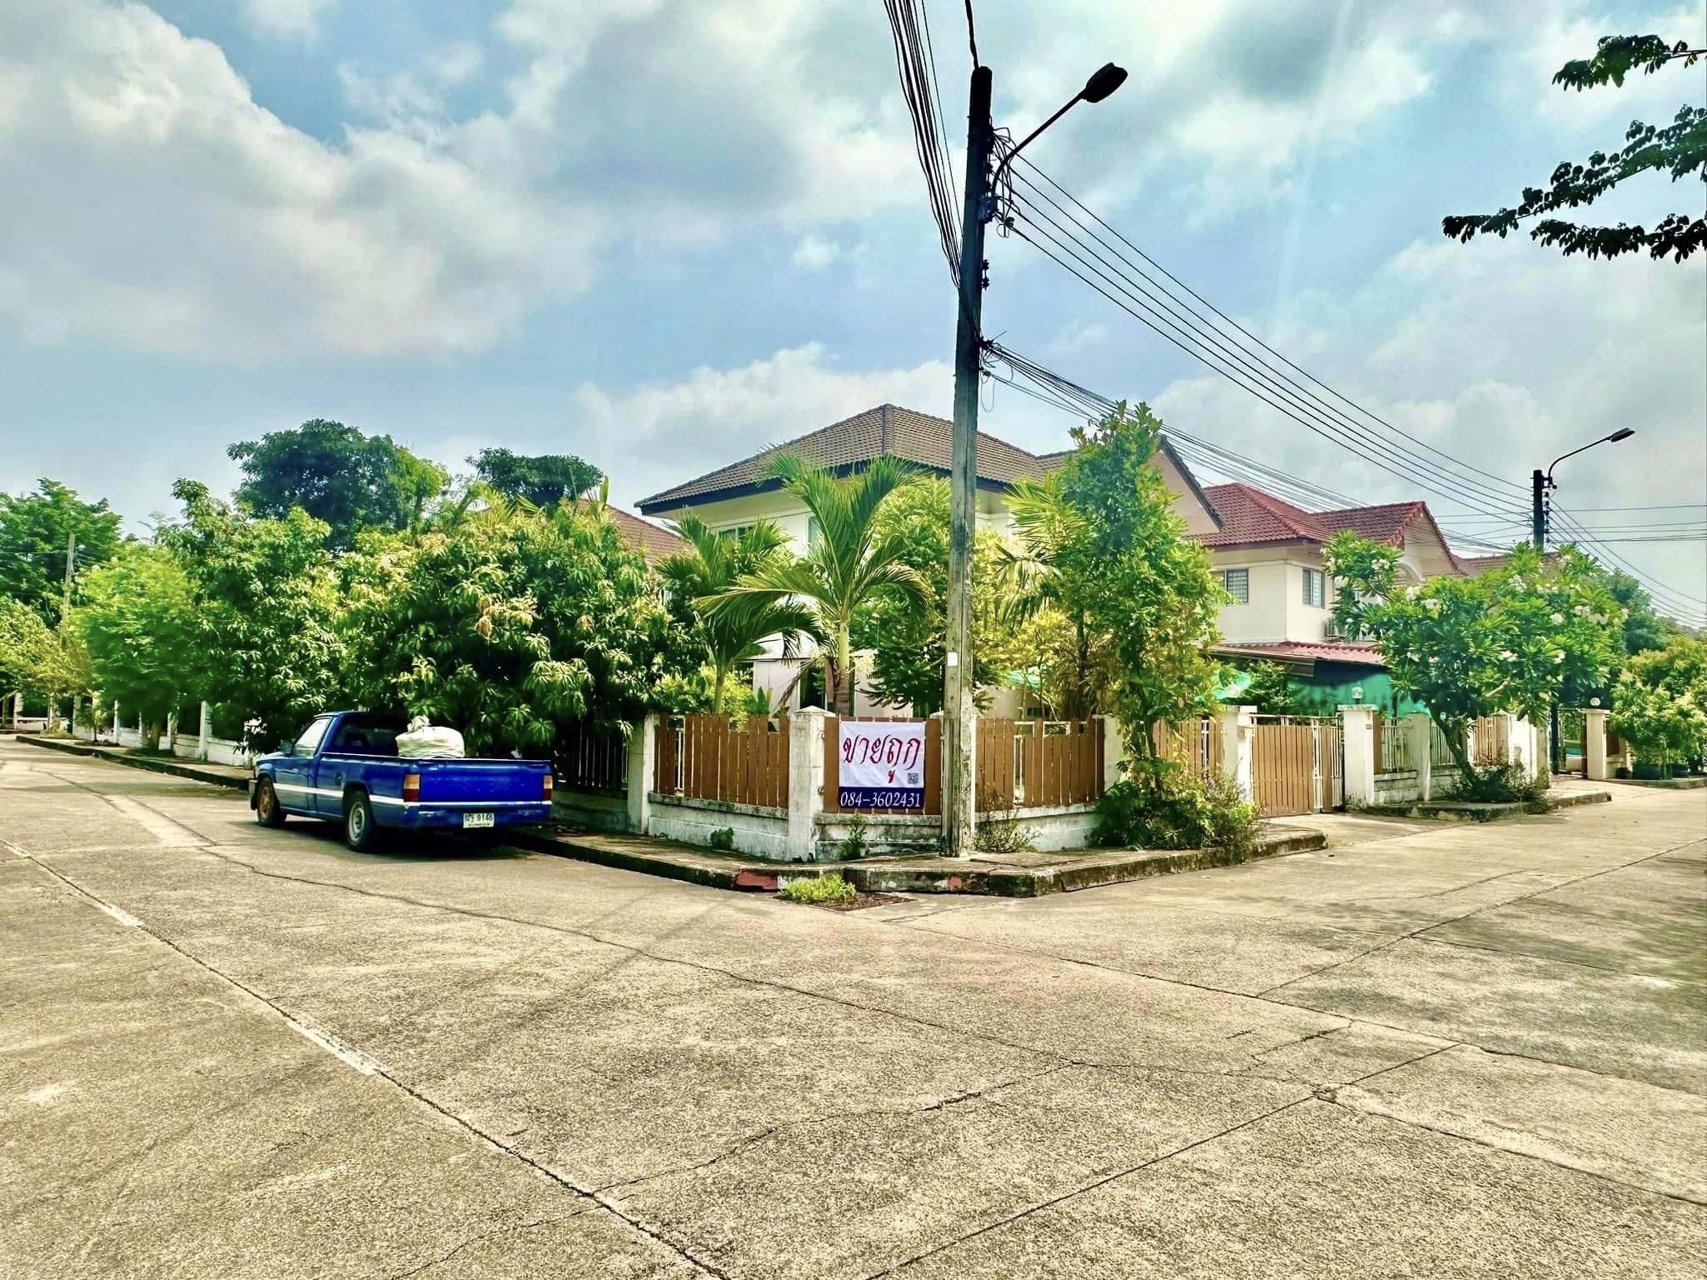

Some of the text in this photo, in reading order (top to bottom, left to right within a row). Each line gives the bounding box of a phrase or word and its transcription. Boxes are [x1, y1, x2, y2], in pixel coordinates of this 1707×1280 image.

[843, 734, 921, 783] ขายถูก
[840, 791, 921, 807] 084-3602431
